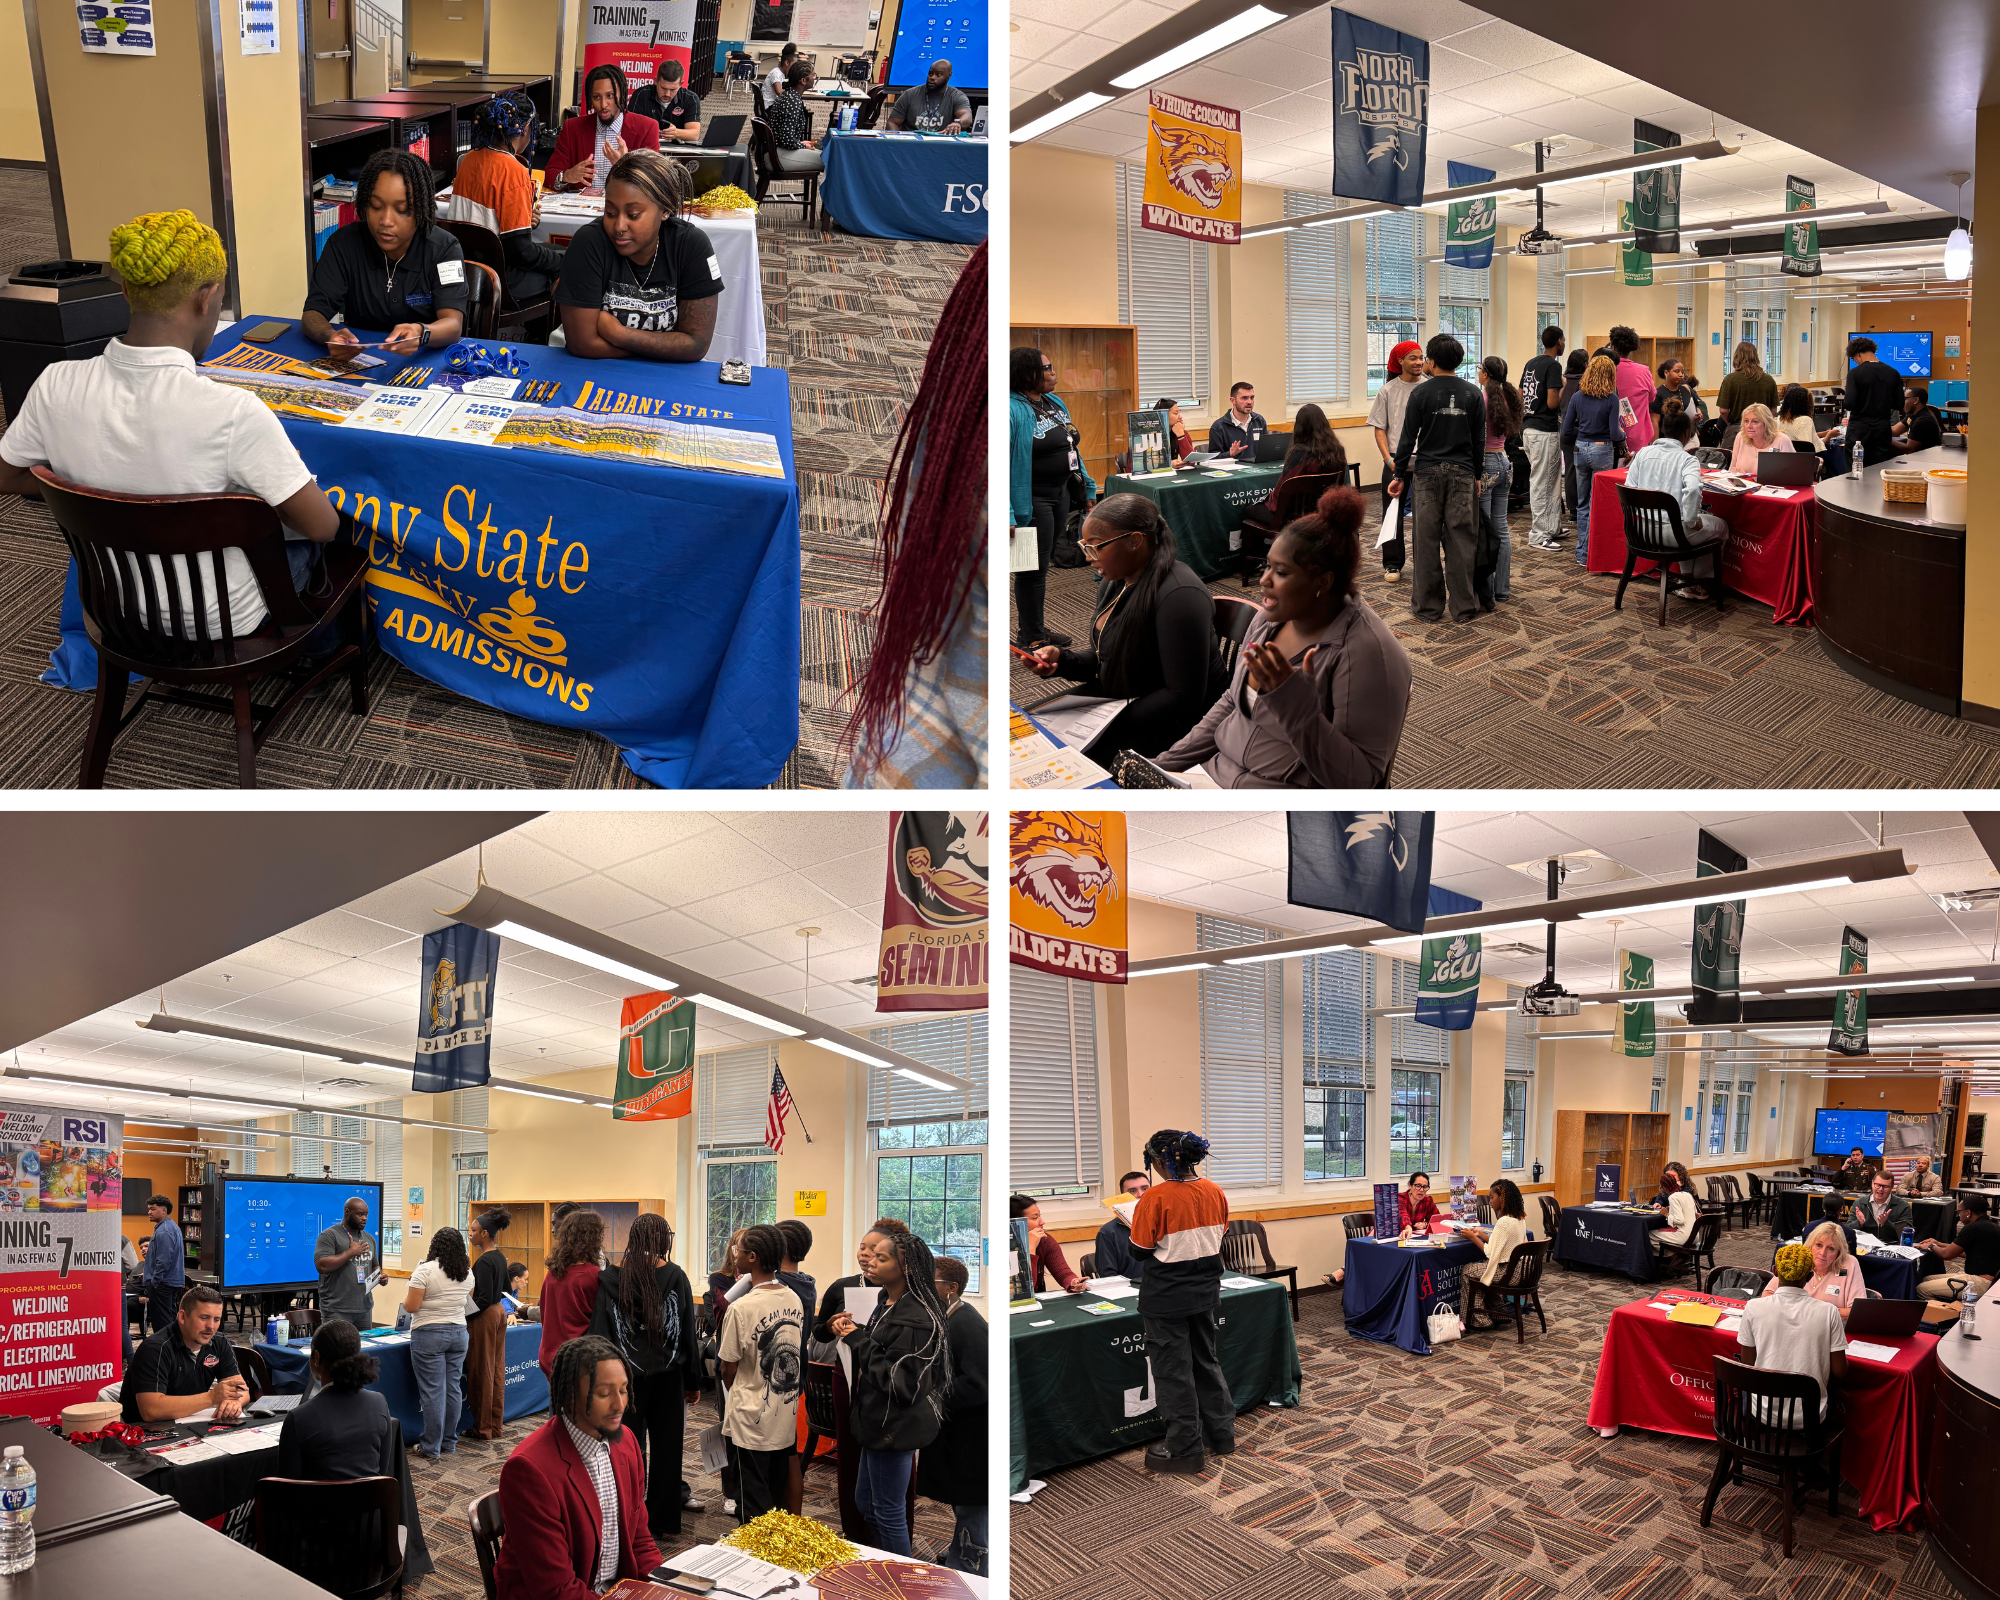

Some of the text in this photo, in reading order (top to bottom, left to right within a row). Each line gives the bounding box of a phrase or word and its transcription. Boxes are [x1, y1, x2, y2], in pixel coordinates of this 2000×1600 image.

[593, 6, 647, 26] TRAINING
[642, 30, 649, 38] AS
[648, 20, 660, 49] 7
[659, 31, 688, 42] MONTHS!
[620, 61, 653, 74] WELDING
[915, 115, 944, 127] FSCJ
[1148, 205, 1235, 239] WILDCATS
[212, 346, 293, 371] ALBANY
[374, 397, 418, 407] HERE
[591, 387, 734, 419] ALBANY STATE
[465, 408, 511, 419] HERE
[1135, 432, 1163, 453] JU
[1224, 487, 1275, 499] JACKSON
[435, 484, 589, 594] State
[1731, 535, 1763, 555] SIONS
[383, 607, 594, 712] ADMISSIONS
[909, 928, 988, 946] FLORIDA S
[1010, 926, 1118, 975] ILDCATS
[624, 1069, 693, 1116] HURRICANES
[1, 1121, 44, 1133] WELDING
[7, 1113, 36, 1123] TULSA
[1889, 1114, 1928, 1124] HONOR
[64, 1118, 106, 1144] RSI
[805, 1200, 811, 1209] 3
[1575, 1228, 1590, 1239] UNF
[7, 1237, 115, 1278] IN AS FEW AS 7 MONTHS!
[1437, 1265, 1463, 1280] UNIVE
[48, 1283, 82, 1291] INCLUDE
[1437, 1276, 1461, 1292] SOUT
[12, 1296, 69, 1316] WELDING
[0, 1316, 107, 1344] C/REFRIGERATION
[4, 1343, 76, 1367] ELECTRICAL
[504, 1359, 540, 1375] State Colleg
[0, 1371, 35, 1393] RICAL
[38, 1362, 114, 1388] LINEWORKER
[504, 1373, 526, 1386] onville
[1670, 1373, 1714, 1391] OFFIC
